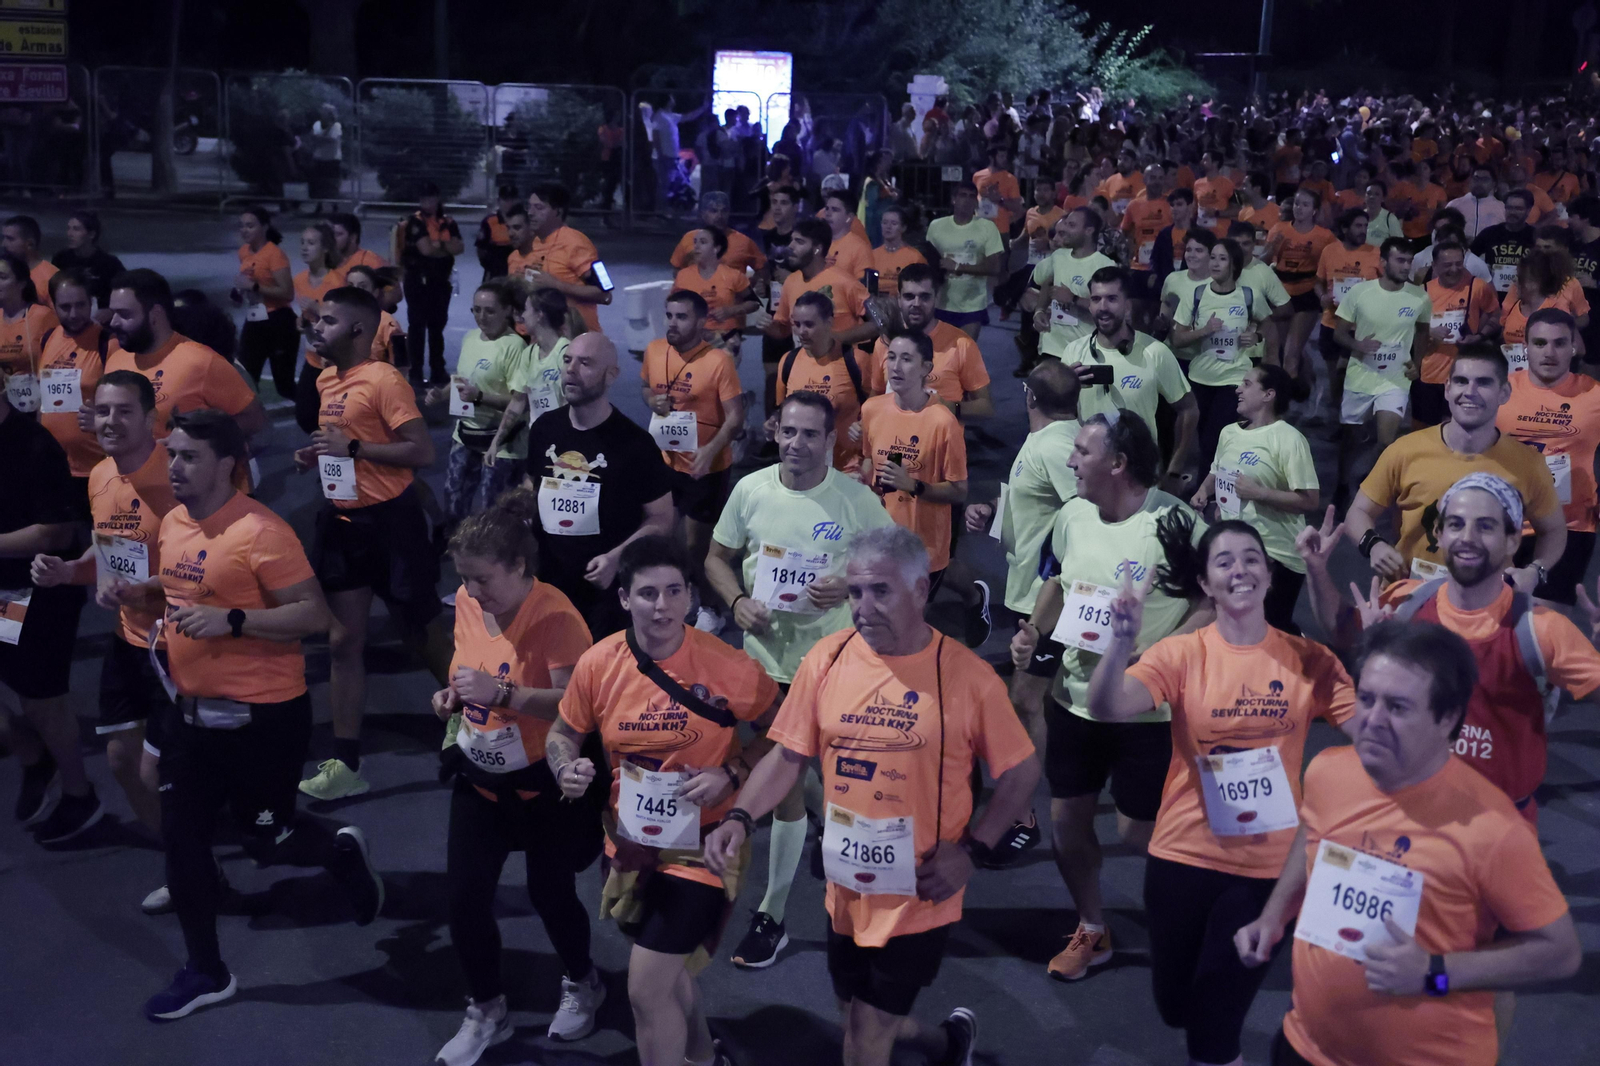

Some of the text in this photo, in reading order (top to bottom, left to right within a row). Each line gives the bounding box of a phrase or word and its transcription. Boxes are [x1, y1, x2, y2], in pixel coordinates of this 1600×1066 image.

[21, 39, 62, 53] Armas
[23, 67, 62, 81] Forum
[19, 83, 63, 97] Sevilla
[1210, 337, 1234, 346] 18158
[1373, 353, 1397, 361] 18149
[47, 383, 73, 395] 19675
[1121, 375, 1143, 390] Fili
[1517, 415, 1551, 424] SEVILLA
[1535, 411, 1573, 420] NOCTURNA
[660, 425, 689, 436] 17635
[889, 445, 920, 455] NOCTURNA
[1238, 451, 1261, 466] Fili
[1216, 477, 1234, 494] 18147
[551, 497, 585, 514] 12881
[97, 522, 124, 530] SEVILLA
[812, 521, 844, 541] Fili
[110, 555, 137, 575] 8284
[175, 562, 205, 575] NOCTURNA
[772, 567, 816, 586] 18142
[1079, 604, 1111, 627] 1813
[1235, 698, 1289, 707] NOCTURNA
[639, 711, 688, 721] NOCTURNA
[866, 706, 918, 721] NOCTURNA
[1211, 707, 1258, 718] SEVILLA
[618, 721, 660, 731] SEVILLA
[840, 713, 885, 727] SEVILLA
[1461, 723, 1493, 742] RNA
[1448, 738, 1493, 760] 012
[470, 747, 505, 766] 5856
[1219, 777, 1273, 801] 16979
[636, 793, 677, 817] 7445
[841, 837, 895, 864] 21866
[1332, 882, 1394, 922] 16986
